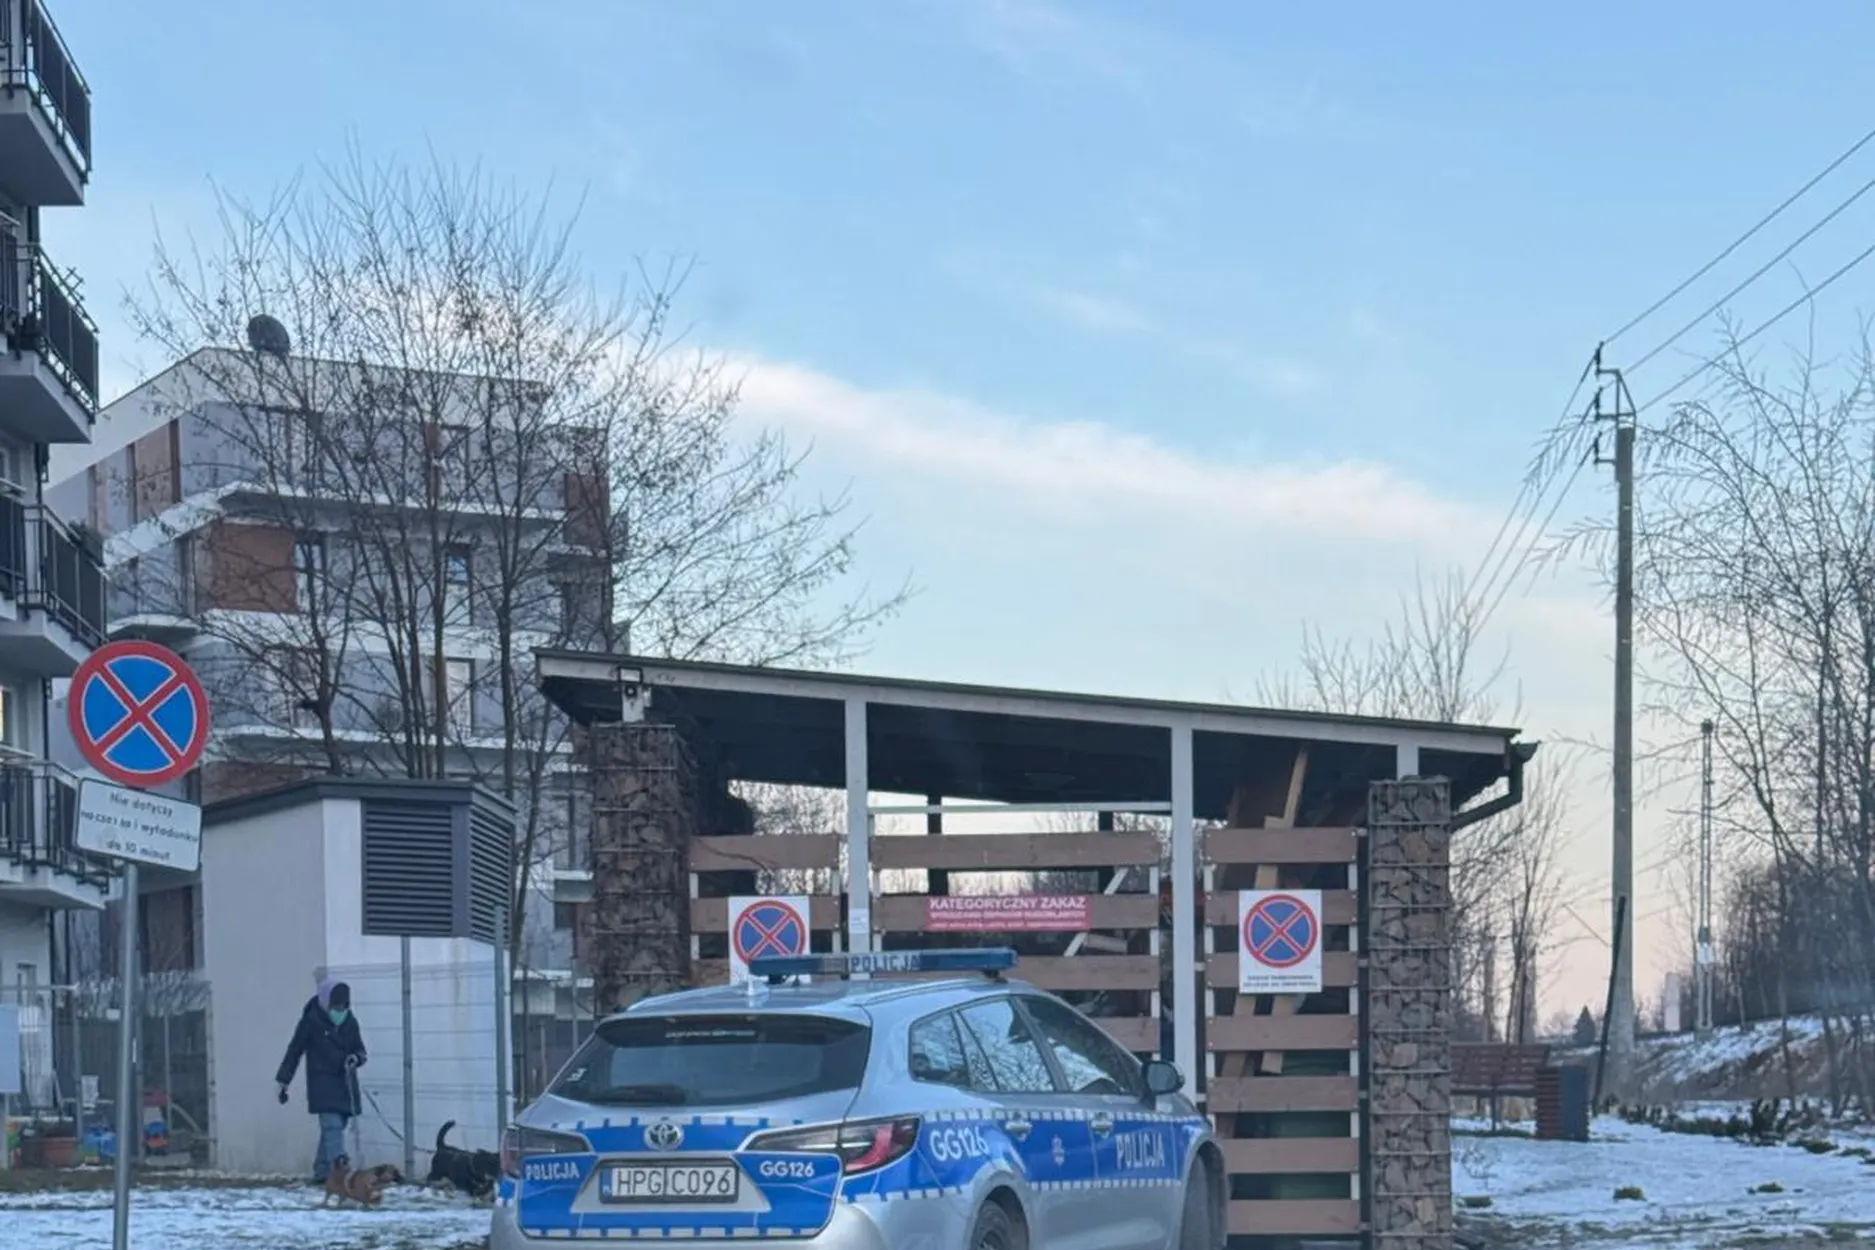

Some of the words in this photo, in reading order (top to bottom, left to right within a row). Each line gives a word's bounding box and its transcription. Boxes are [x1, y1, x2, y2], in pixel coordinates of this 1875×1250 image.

[109, 791, 129, 806] Nie
[132, 798, 173, 818] dotyczy
[930, 897, 1038, 910] KATEGORYCZNY
[1041, 896, 1086, 909] ZAKAZ
[851, 954, 920, 972] POLICJA
[928, 1128, 988, 1162] GG126
[1115, 1132, 1165, 1169] POLICJA
[525, 1161, 581, 1181] POLICJA
[759, 1160, 815, 1177] GG126
